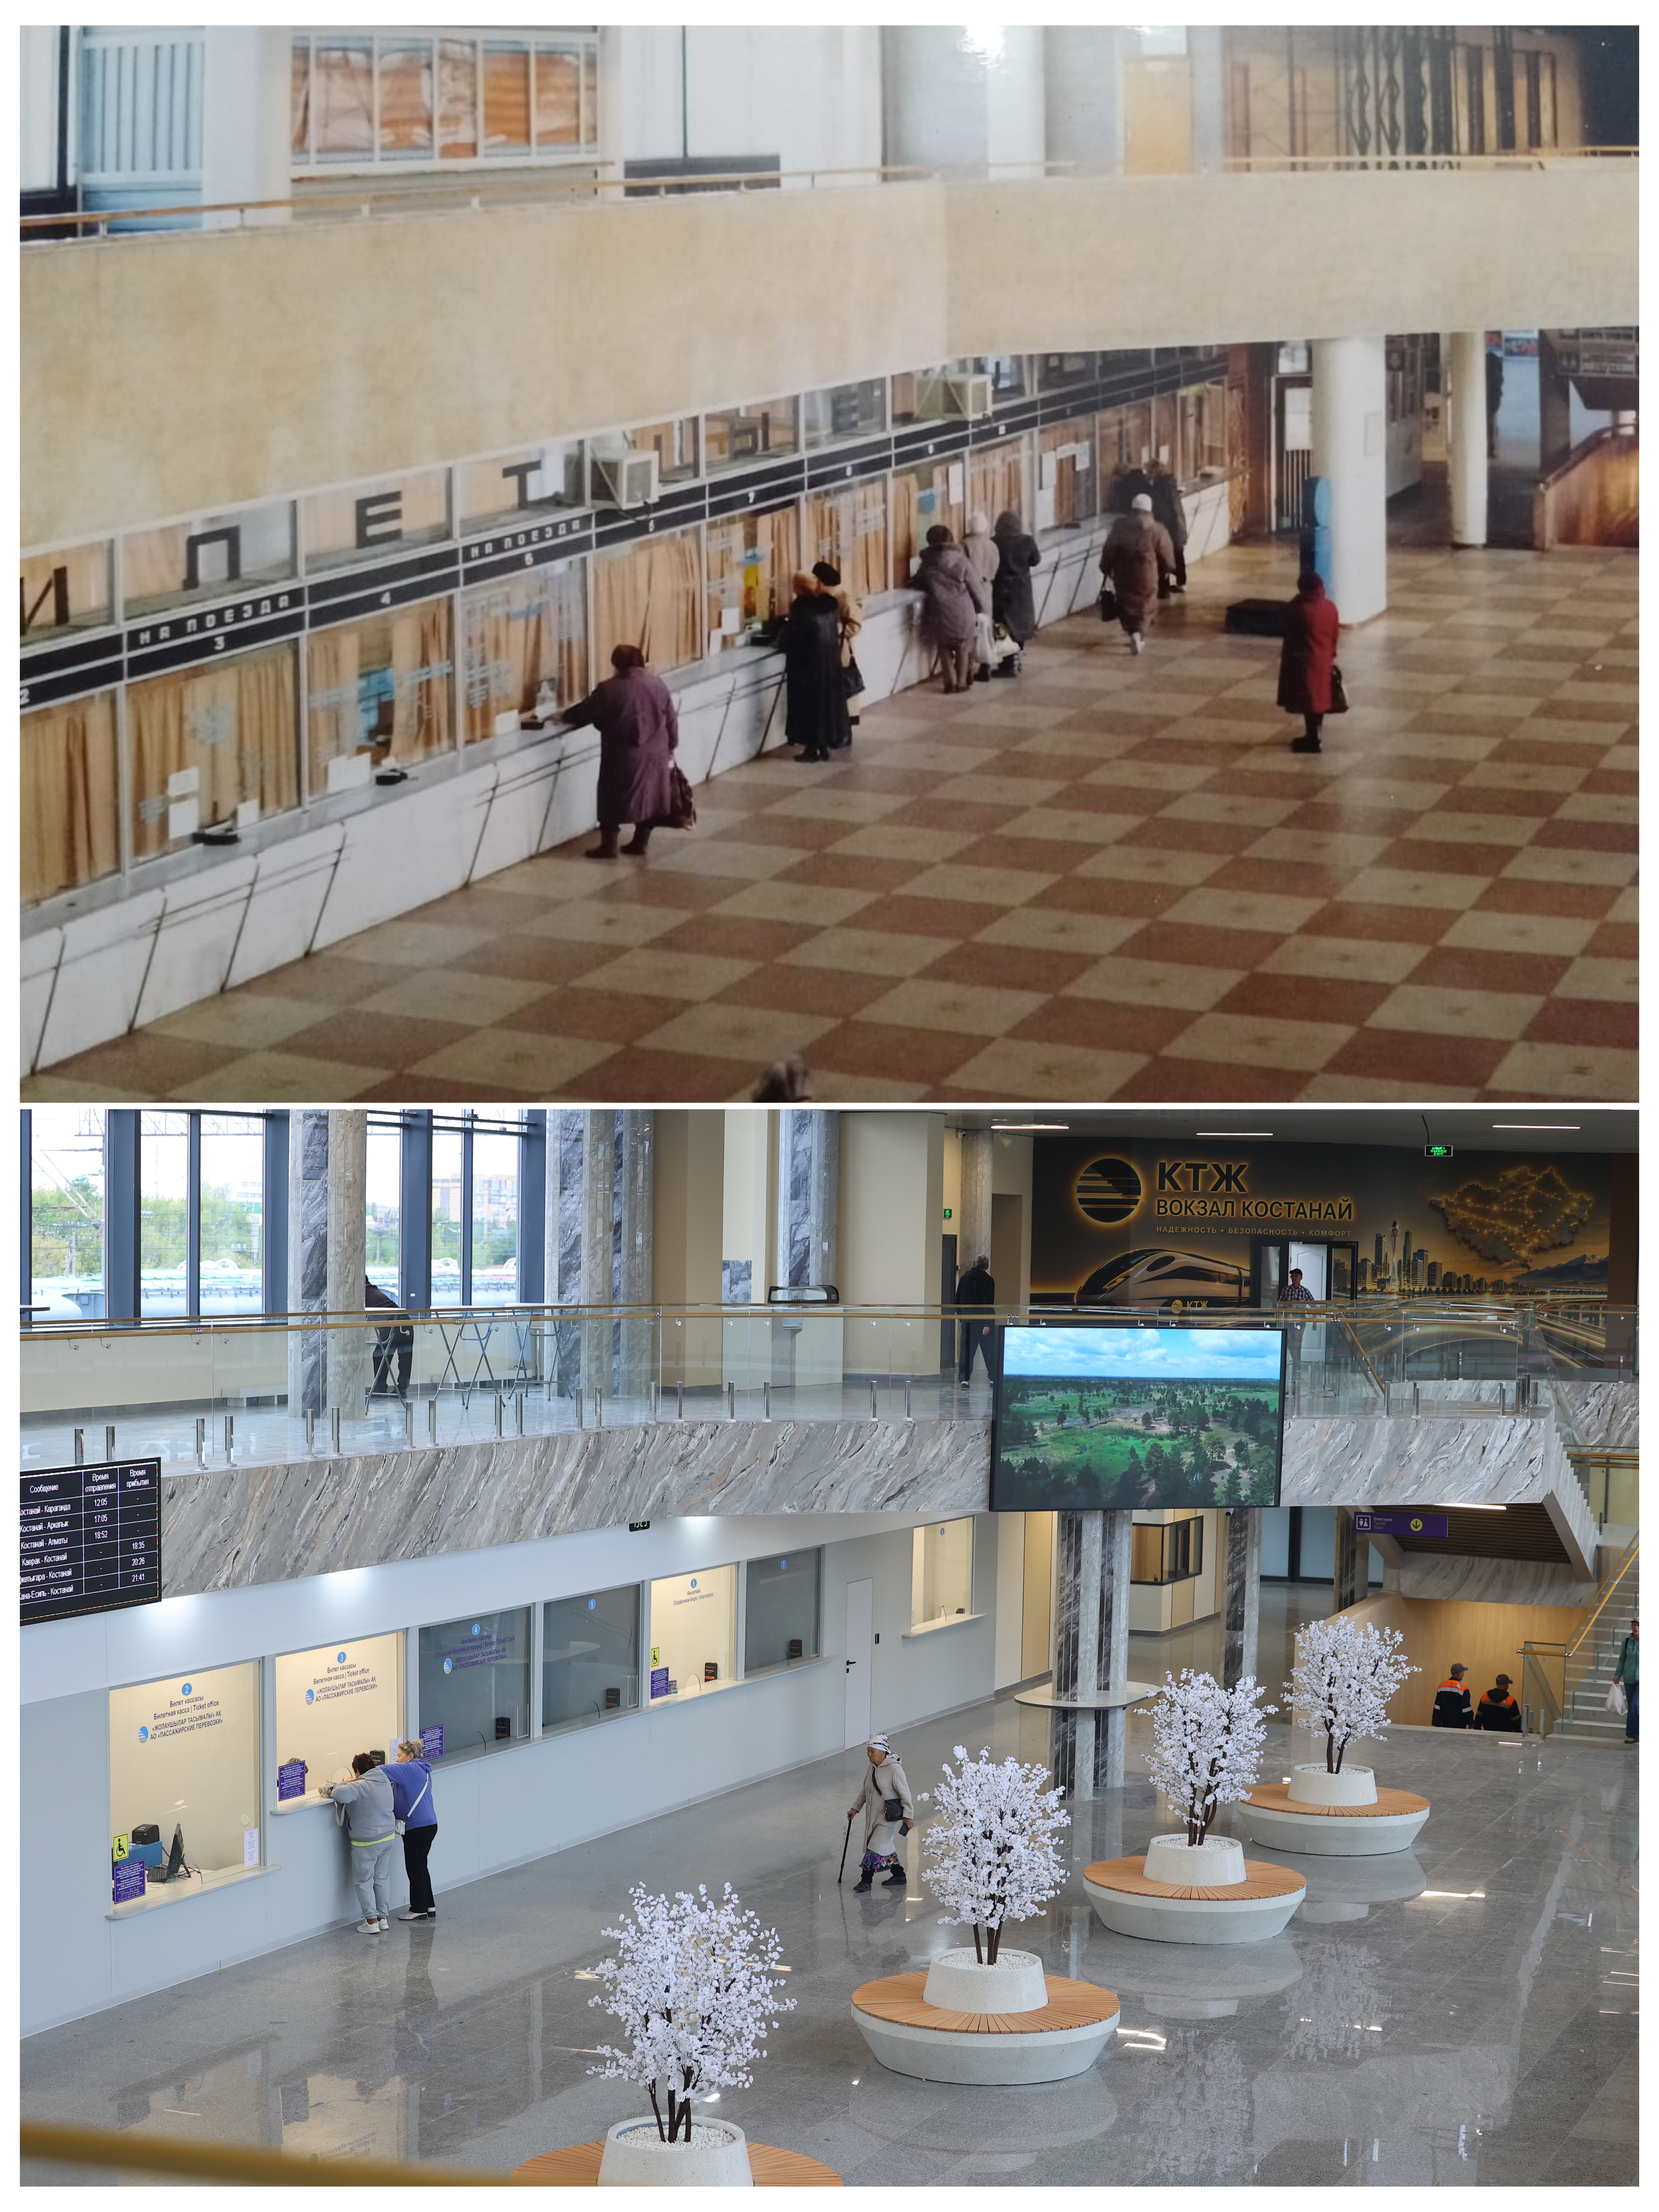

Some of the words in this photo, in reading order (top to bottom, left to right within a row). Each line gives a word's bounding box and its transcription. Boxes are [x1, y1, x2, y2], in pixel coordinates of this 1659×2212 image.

[471, 542, 493, 559] НА
[504, 519, 580, 549] ПОЕЗДА
[381, 591, 391, 604] 4
[139, 626, 170, 645] НА
[186, 595, 289, 633] ПОЕЗДА
[214, 636, 225, 650] 3
[20, 689, 30, 705] 2
[1158, 1162, 1248, 1193] КТЖ
[1157, 1199, 1235, 1217] ВОКЗАЛ
[1242, 1198, 1352, 1220] КОСТАНАЙ
[1156, 1226, 1217, 1234] НАДЕЖНОСТЬ
[1228, 1228, 1297, 1236] БЕЗОПАСНОСТЬ
[92, 1473, 109, 1482] Время
[130, 1469, 146, 1478] Время
[30, 1484, 59, 1493] Сообщение
[85, 1482, 116, 1493] отправления
[126, 1478, 149, 1488] прибытия
[94, 1498, 107, 1506] 12:05
[20, 1506, 41, 1516] останай
[44, 1504, 71, 1514] Караганда
[94, 1514, 108, 1523] 17:05
[20, 1523, 43, 1533] Костанай
[47, 1521, 69, 1530] Аркалык
[94, 1531, 108, 1539] 18:52
[21, 1539, 44, 1549] Костанай
[48, 1538, 68, 1546] Алматы
[132, 1541, 145, 1550] 18:35
[22, 1558, 41, 1566] Каерак
[44, 1553, 67, 1563] Костанай
[132, 1557, 145, 1566] 20:26
[49, 1568, 72, 1579] Костанай
[132, 1574, 145, 1582] 21:41
[50, 1585, 74, 1595] Костанай
[474, 1625, 478, 1634] 4
[436, 1649, 452, 1658] Старший
[452, 1645, 470, 1654] билетный
[340, 1653, 343, 1662] 3
[458, 1658, 486, 1670] «ПАССАЖИРСКИЕ
[487, 1654, 507, 1663] ПЕРЕВОЗКИ»
[313, 1677, 332, 1685] Билетная
[317, 1683, 346, 1694] «ЖОЛАУШЫЛАР
[347, 1677, 370, 1687] ТАСЫМАЛЫ»
[185, 1685, 189, 1694] 2
[322, 1688, 354, 1700] «ПАССАЖИРСКИЕ
[354, 1684, 377, 1693] ПЕРЕВОЗКИ»
[185, 1696, 204, 1704] кассасы
[154, 1711, 176, 1720] Билетная
[193, 1702, 206, 1711] Ticket
[152, 1719, 186, 1732] «ЖОЛАУШЫЛАР
[188, 1712, 215, 1724] ТАСЫМАЛЫ»
[158, 1724, 195, 1738] «ПАССАЖИРСКИЕ
[196, 1719, 223, 1730] ПЕРЕВОЗКИ»
